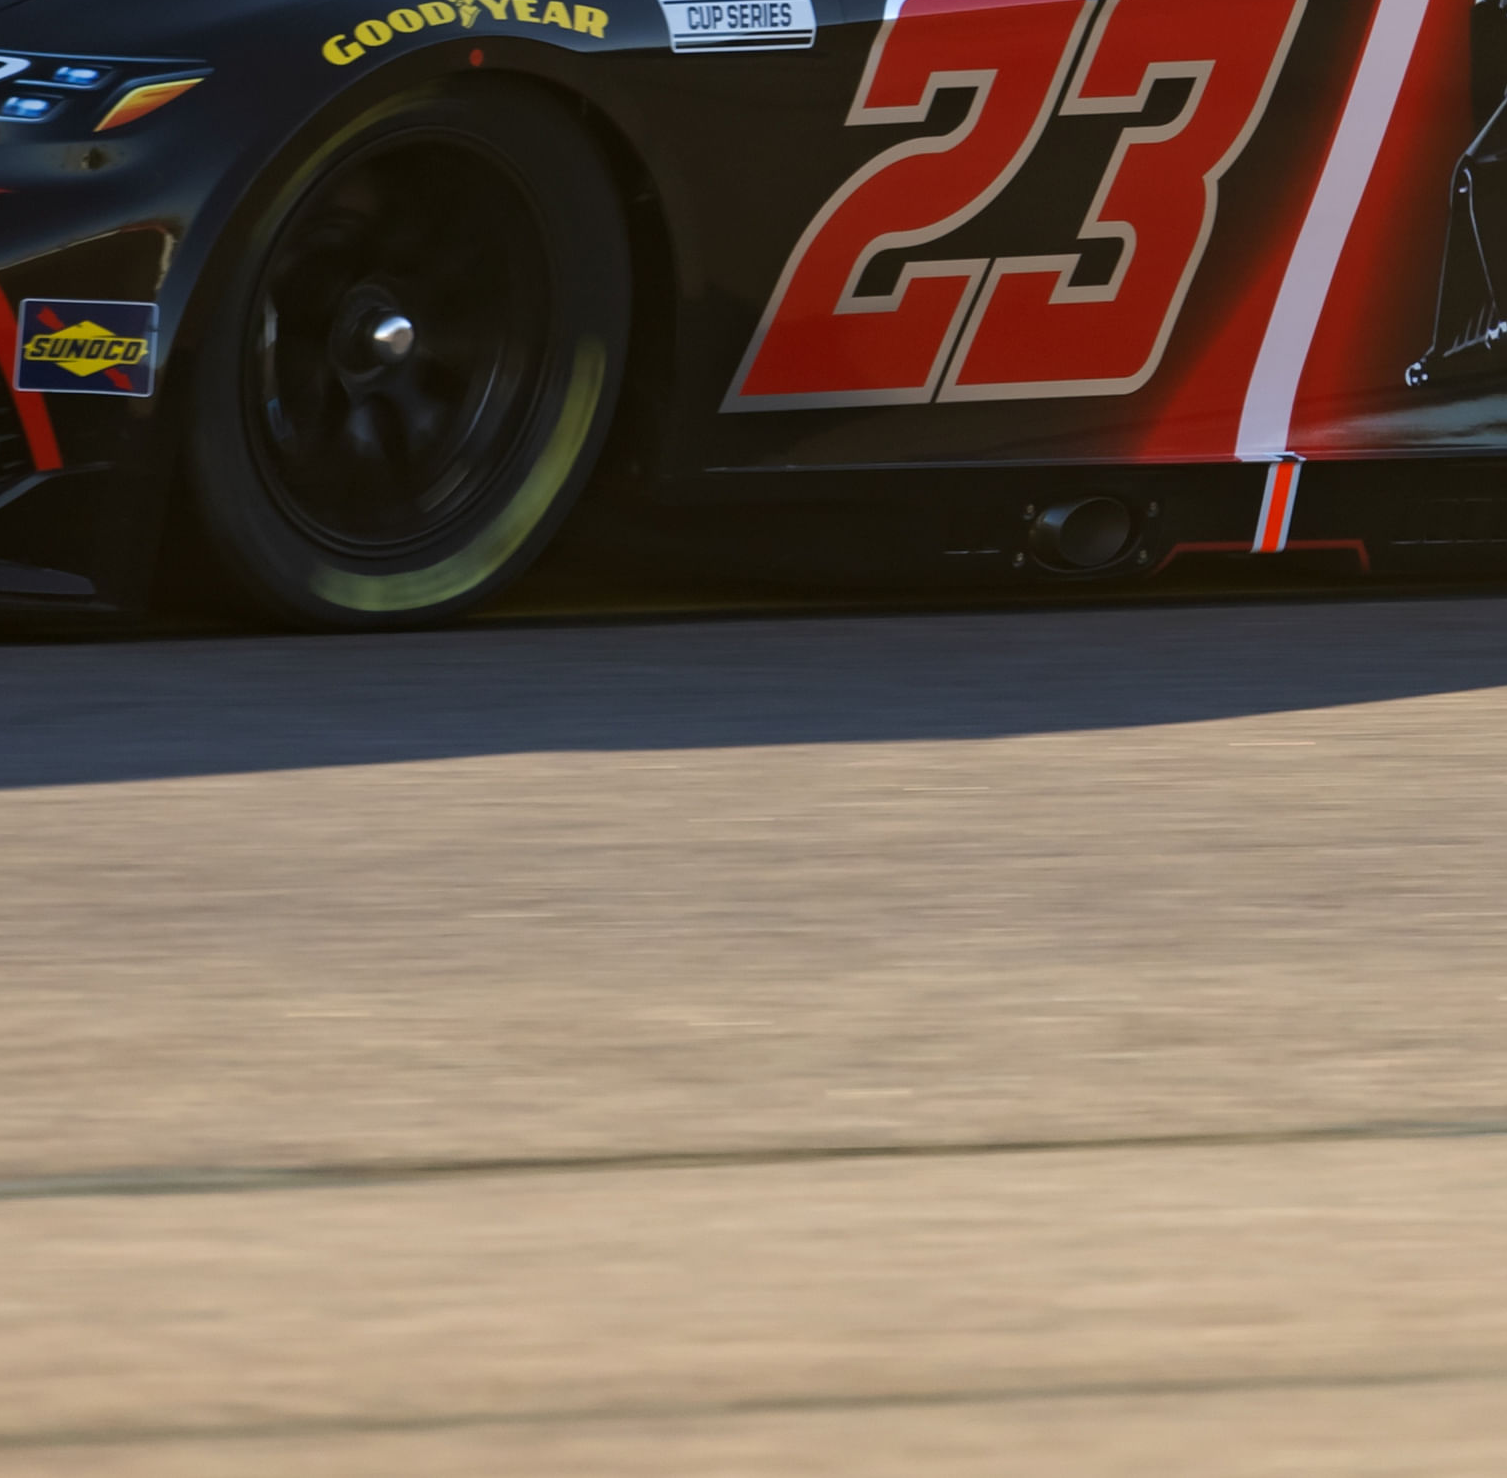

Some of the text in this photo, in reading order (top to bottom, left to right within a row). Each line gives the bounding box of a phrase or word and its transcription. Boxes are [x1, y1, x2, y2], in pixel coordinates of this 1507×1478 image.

[687, 1, 793, 31] CUP SERIES
[31, 336, 143, 363] SUNOCO
